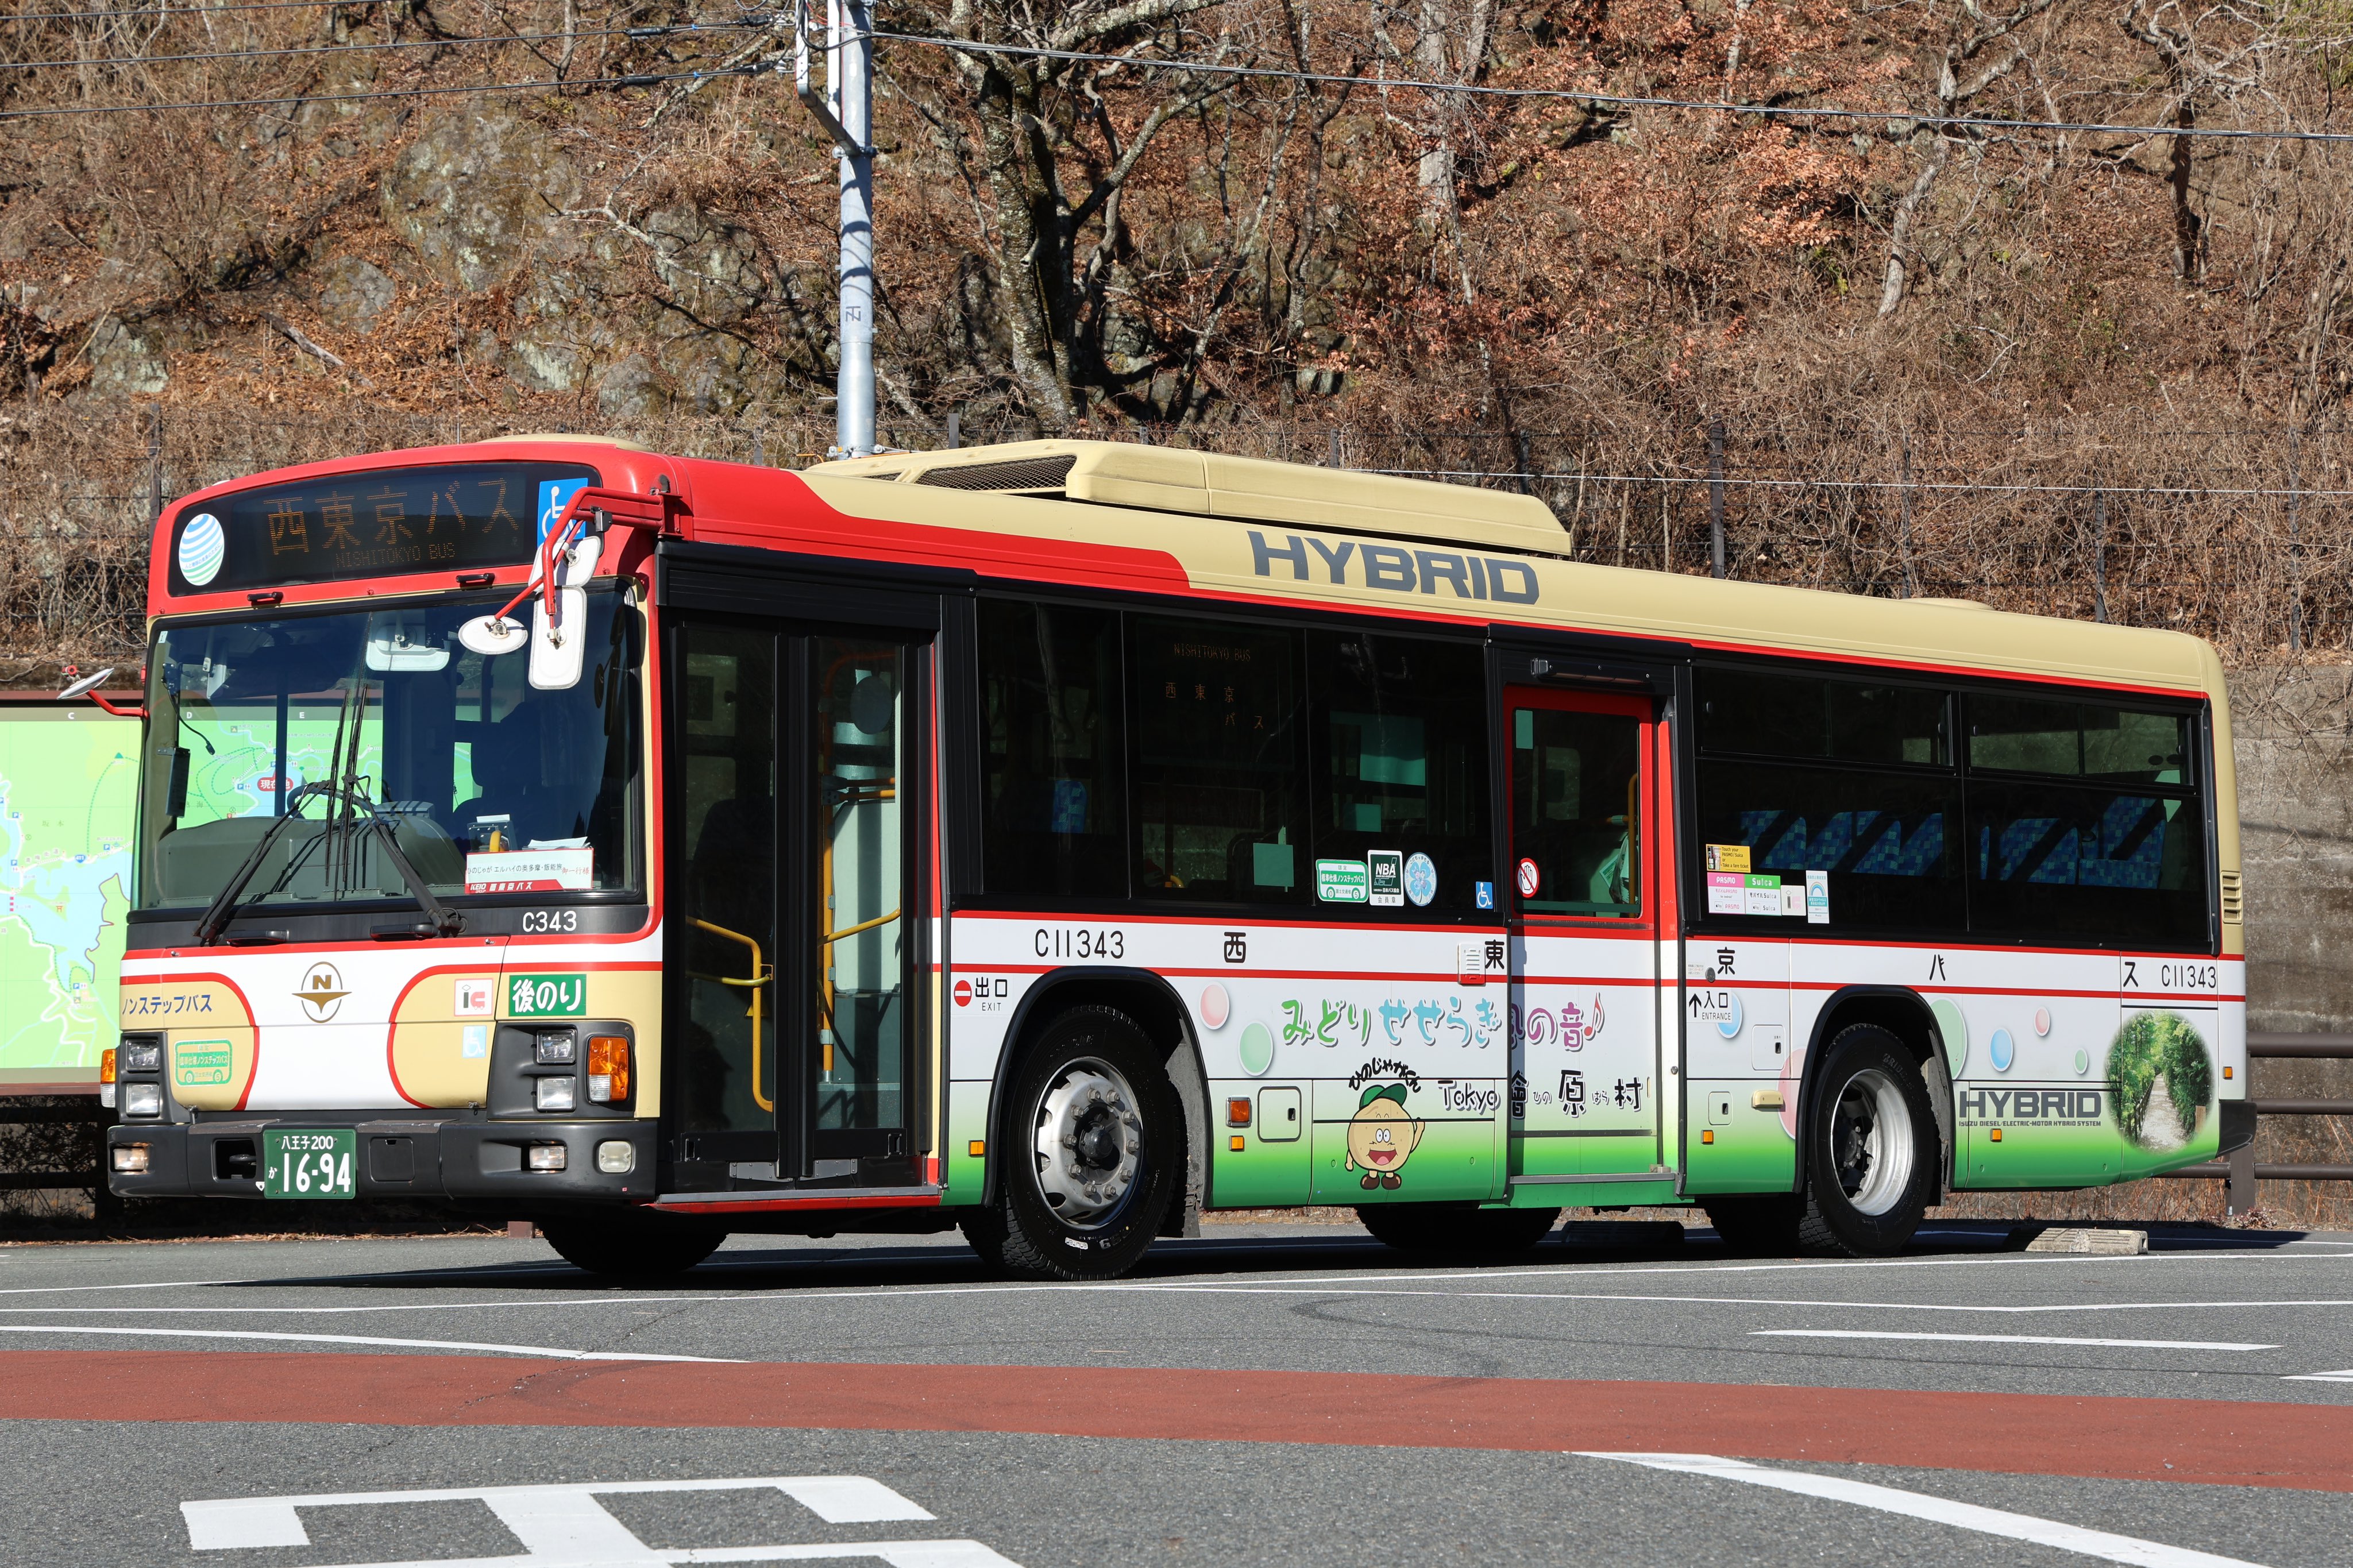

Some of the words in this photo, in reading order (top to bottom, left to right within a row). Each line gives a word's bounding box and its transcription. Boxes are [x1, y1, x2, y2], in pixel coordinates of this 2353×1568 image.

[263, 478, 519, 555] 西東京バス
[335, 545, 421, 568] NISHITOKYO
[429, 542, 456, 561] BUS
[1247, 530, 1540, 605] HYBRID
[1174, 643, 1229, 660] NISHITOKYO
[1235, 648, 1251, 662] BUS
[1165, 682, 1235, 703] 西東京
[1225, 712, 1264, 729] バス
[1376, 863, 1396, 875] NBA
[1716, 876, 1736, 884] PASMO
[489, 882, 533, 891] 西東京バス
[1752, 878, 1772, 886] Suica
[523, 910, 577, 932] C343
[1035, 928, 1124, 959] C11343
[1224, 932, 1247, 963] 西
[1484, 939, 1505, 970] 東
[1716, 947, 1735, 975] 京
[2123, 961, 2139, 988] ス
[2162, 965, 2217, 989] C11343
[512, 979, 581, 1013] 後のり
[975, 976, 1008, 998] 出口
[122, 994, 212, 1015] ノンステップバス
[982, 1002, 1001, 1011] EXIT
[1704, 991, 1728, 1009] 入口
[1702, 1012, 1731, 1020] ENTRANCE
[1437, 1080, 1498, 1112] Tokyo
[1959, 1091, 2101, 1118] HYBRID
[268, 1167, 277, 1179] か
